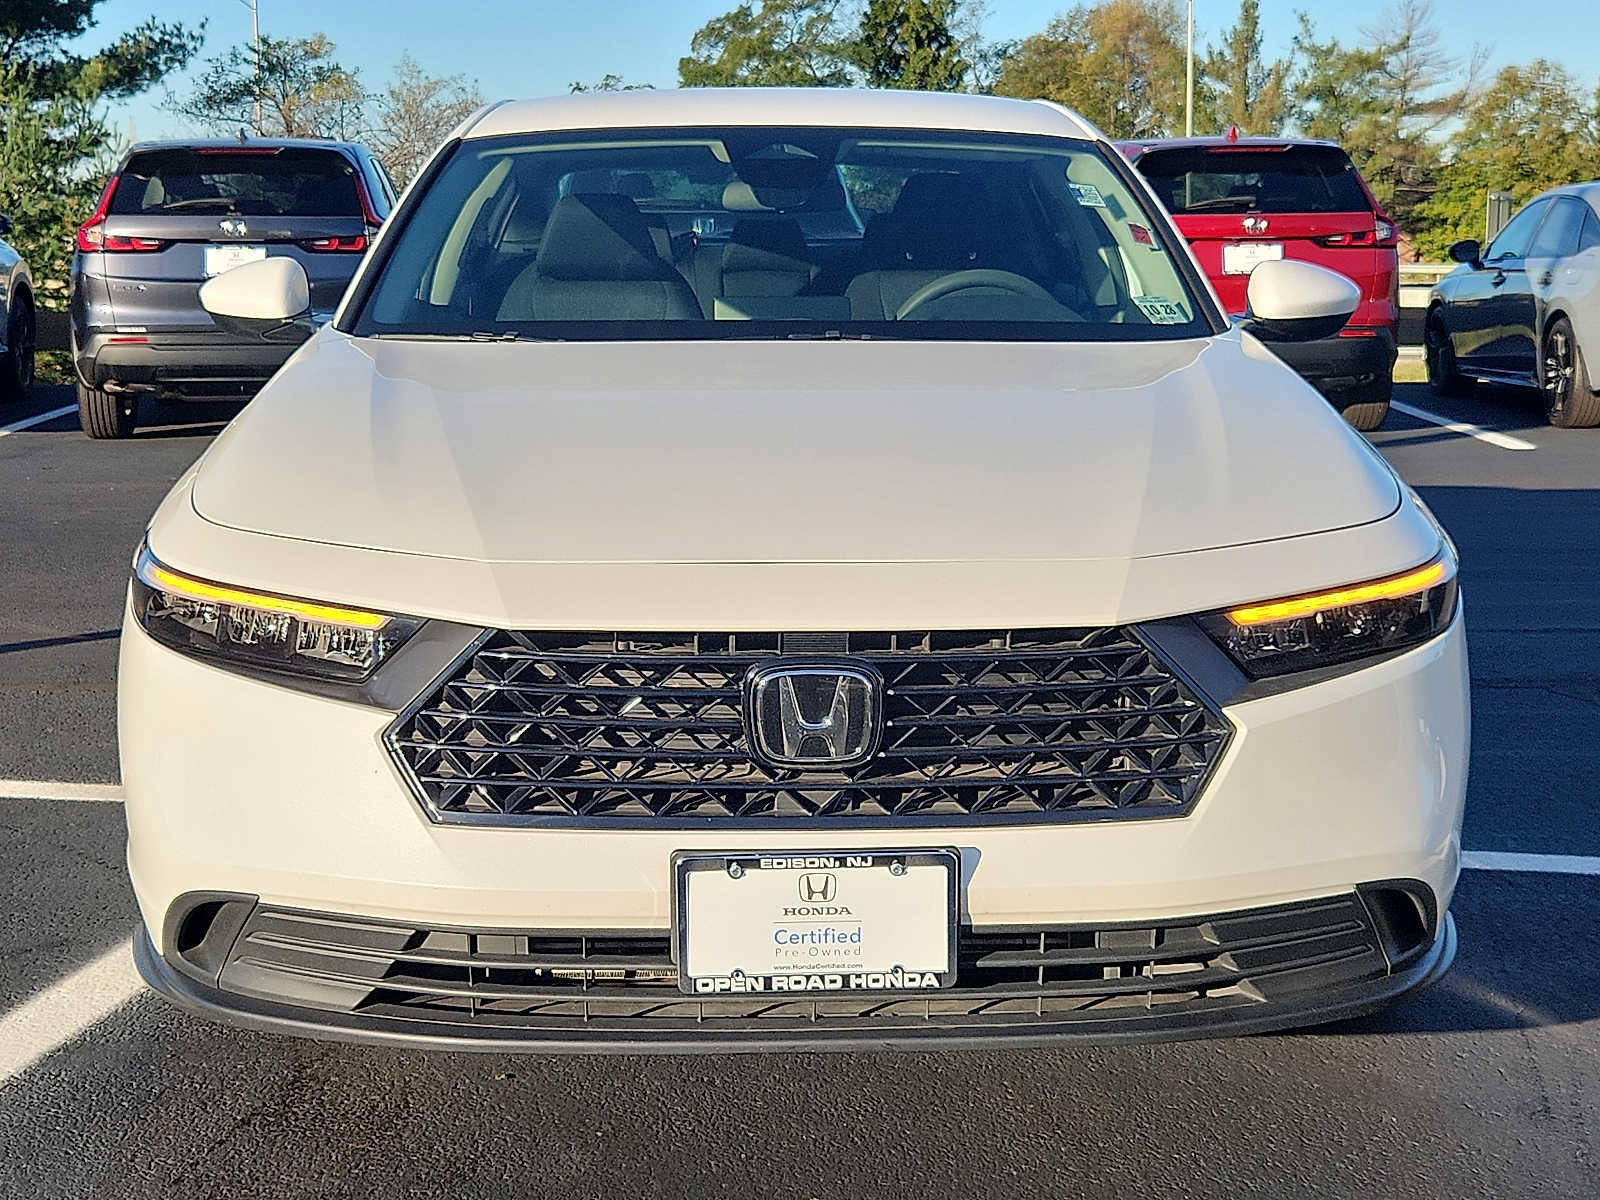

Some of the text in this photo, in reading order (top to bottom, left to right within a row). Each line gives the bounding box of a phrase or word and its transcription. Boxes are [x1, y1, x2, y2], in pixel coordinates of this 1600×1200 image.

[846, 856, 873, 868] NJ
[783, 907, 852, 916] HONDA
[774, 927, 862, 945] Certified
[775, 945, 861, 957] Pre-Owned
[695, 972, 940, 993] OPEN ROAD HONDA
